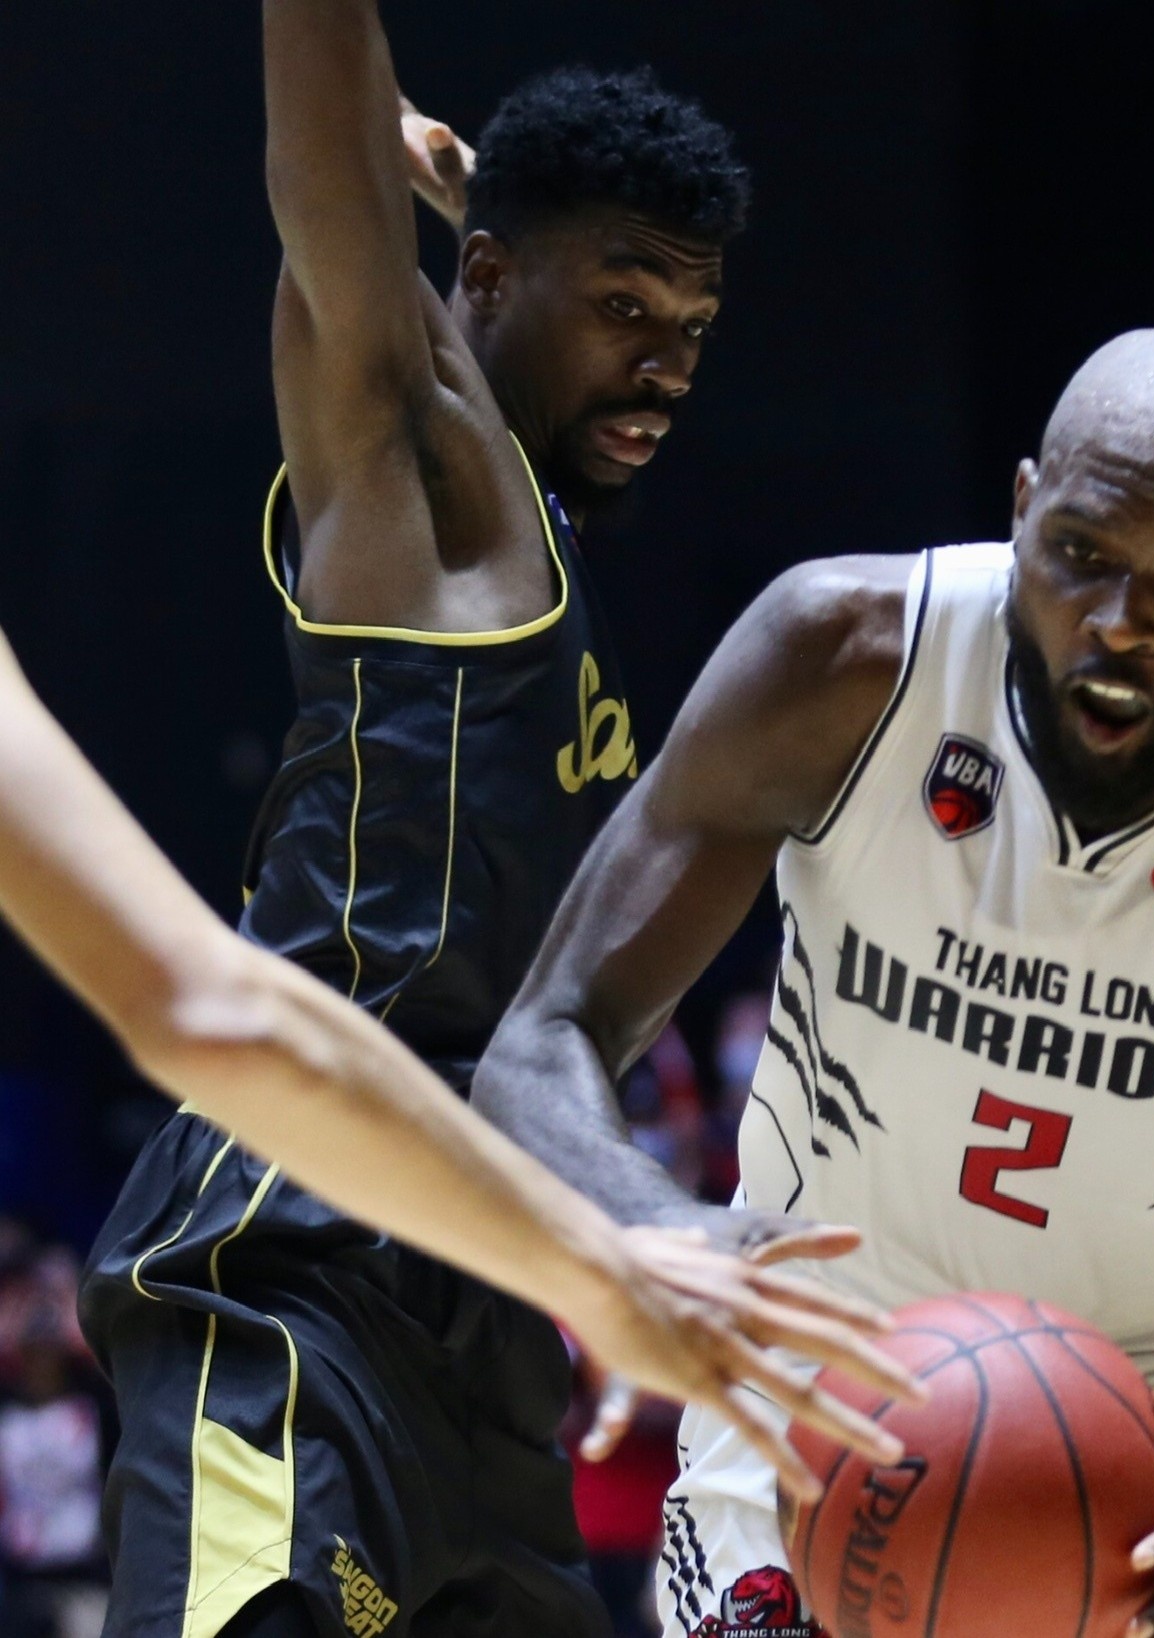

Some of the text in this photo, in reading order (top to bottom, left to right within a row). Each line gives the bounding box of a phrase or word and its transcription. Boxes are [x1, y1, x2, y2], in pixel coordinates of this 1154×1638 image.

[942, 752, 993, 796] VBA
[935, 927, 1068, 1007] THANG
[959, 1087, 1074, 1230] 2
